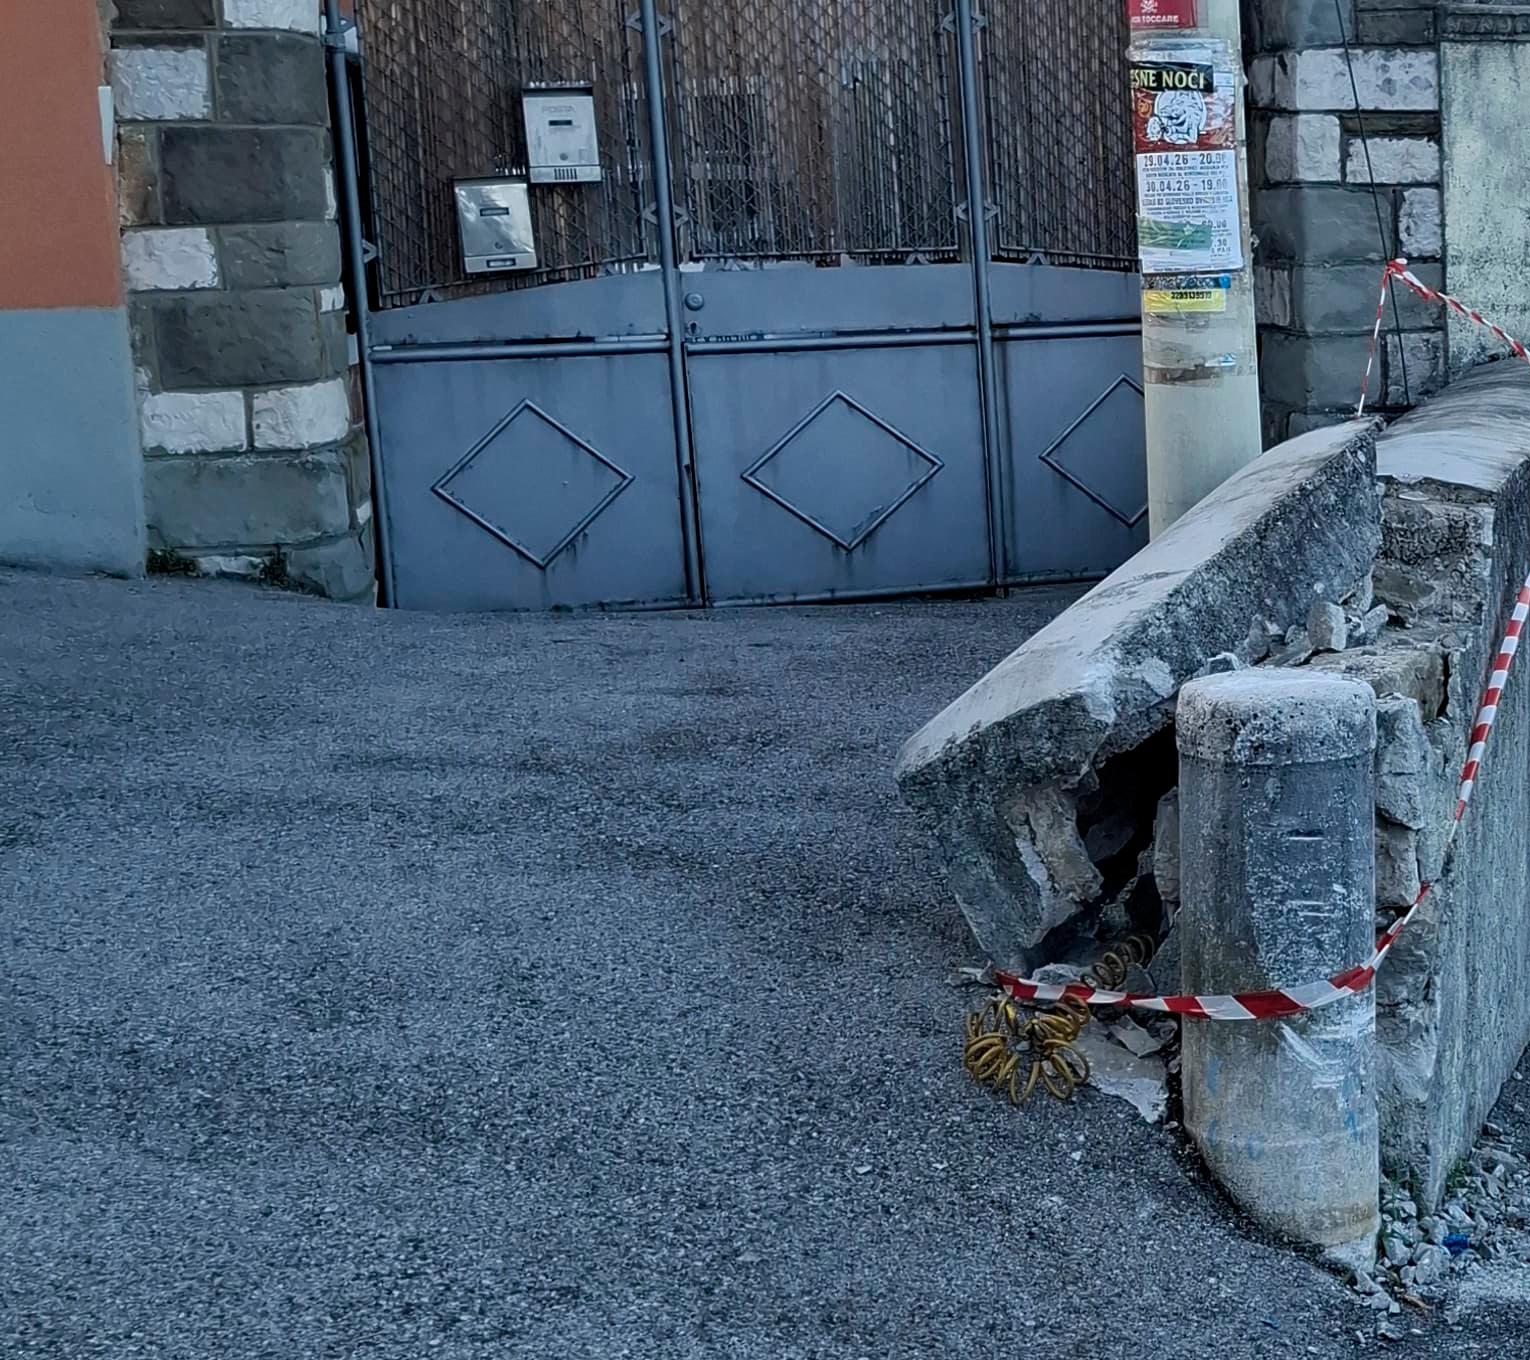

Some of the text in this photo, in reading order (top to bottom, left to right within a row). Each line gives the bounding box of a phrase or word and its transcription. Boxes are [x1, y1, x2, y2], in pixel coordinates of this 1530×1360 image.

[1142, 15, 1179, 23] TOCCARE
[1144, 154, 1189, 167] 29.04.26
[1146, 180, 1191, 193] 30.04.26
